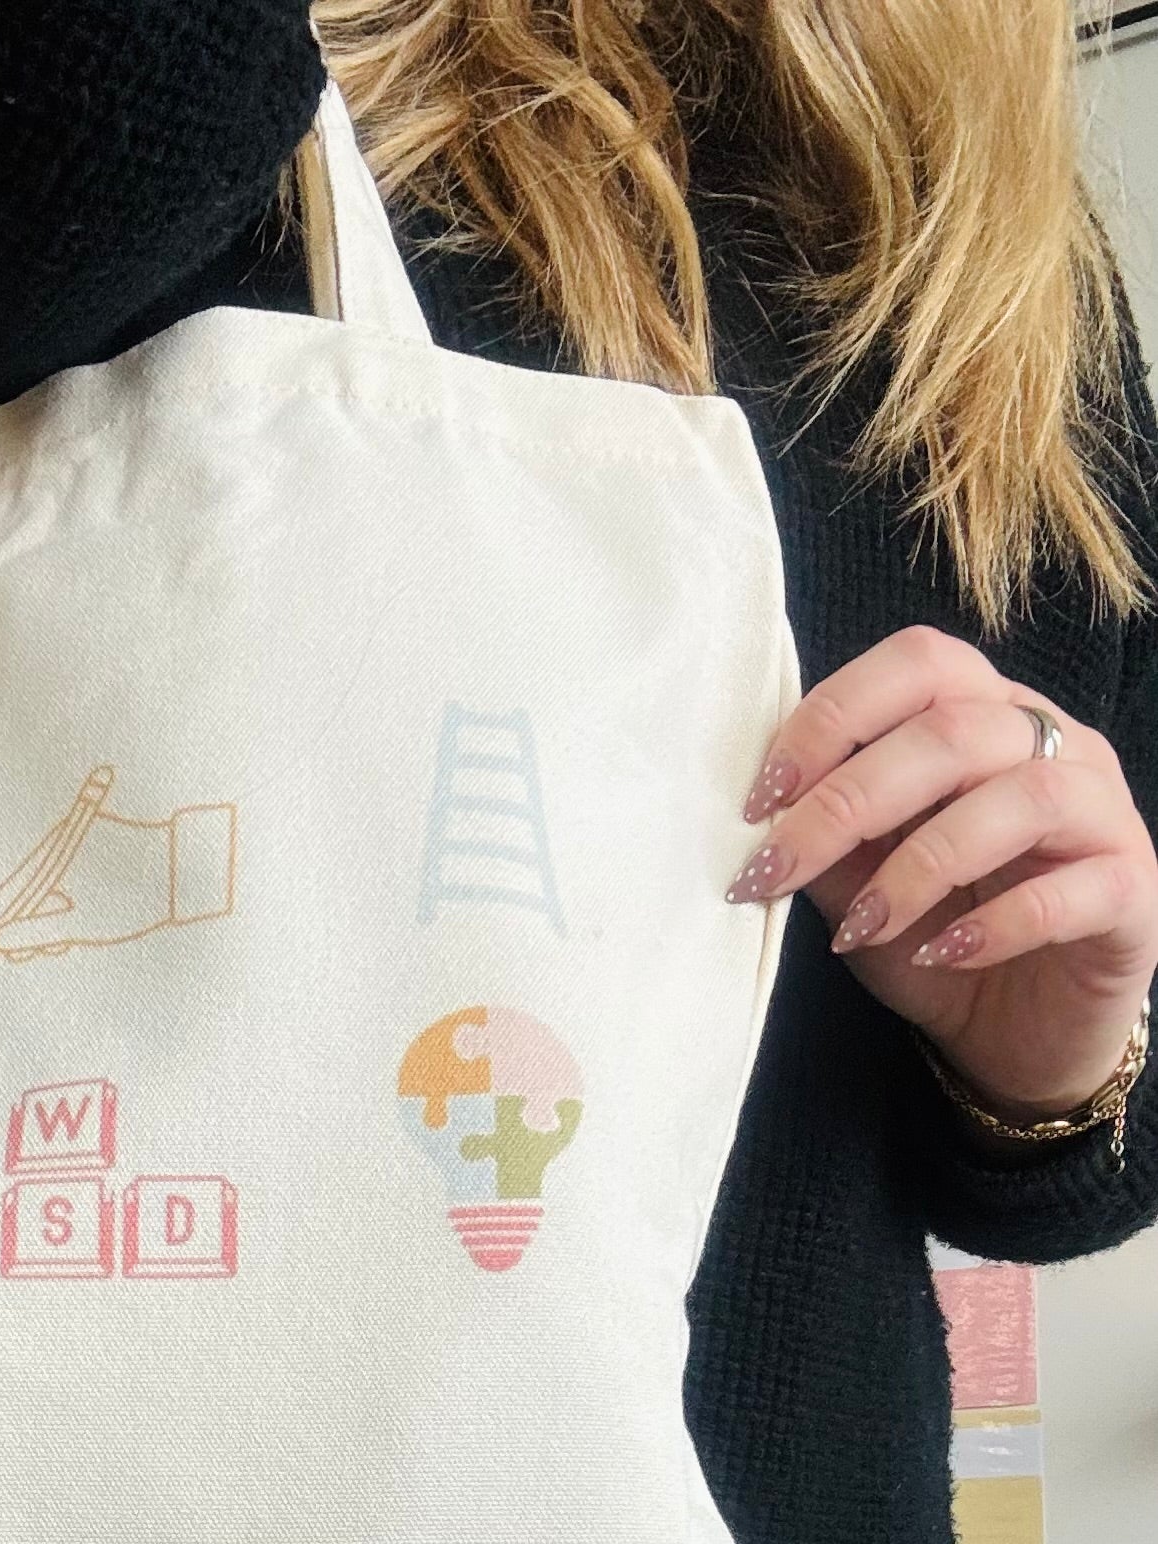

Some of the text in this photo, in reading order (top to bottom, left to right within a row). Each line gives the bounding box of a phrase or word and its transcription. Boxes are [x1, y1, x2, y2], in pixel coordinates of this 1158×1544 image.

[34, 1096, 90, 1143] W
[43, 1196, 74, 1246] S
[166, 1195, 194, 1246] D
